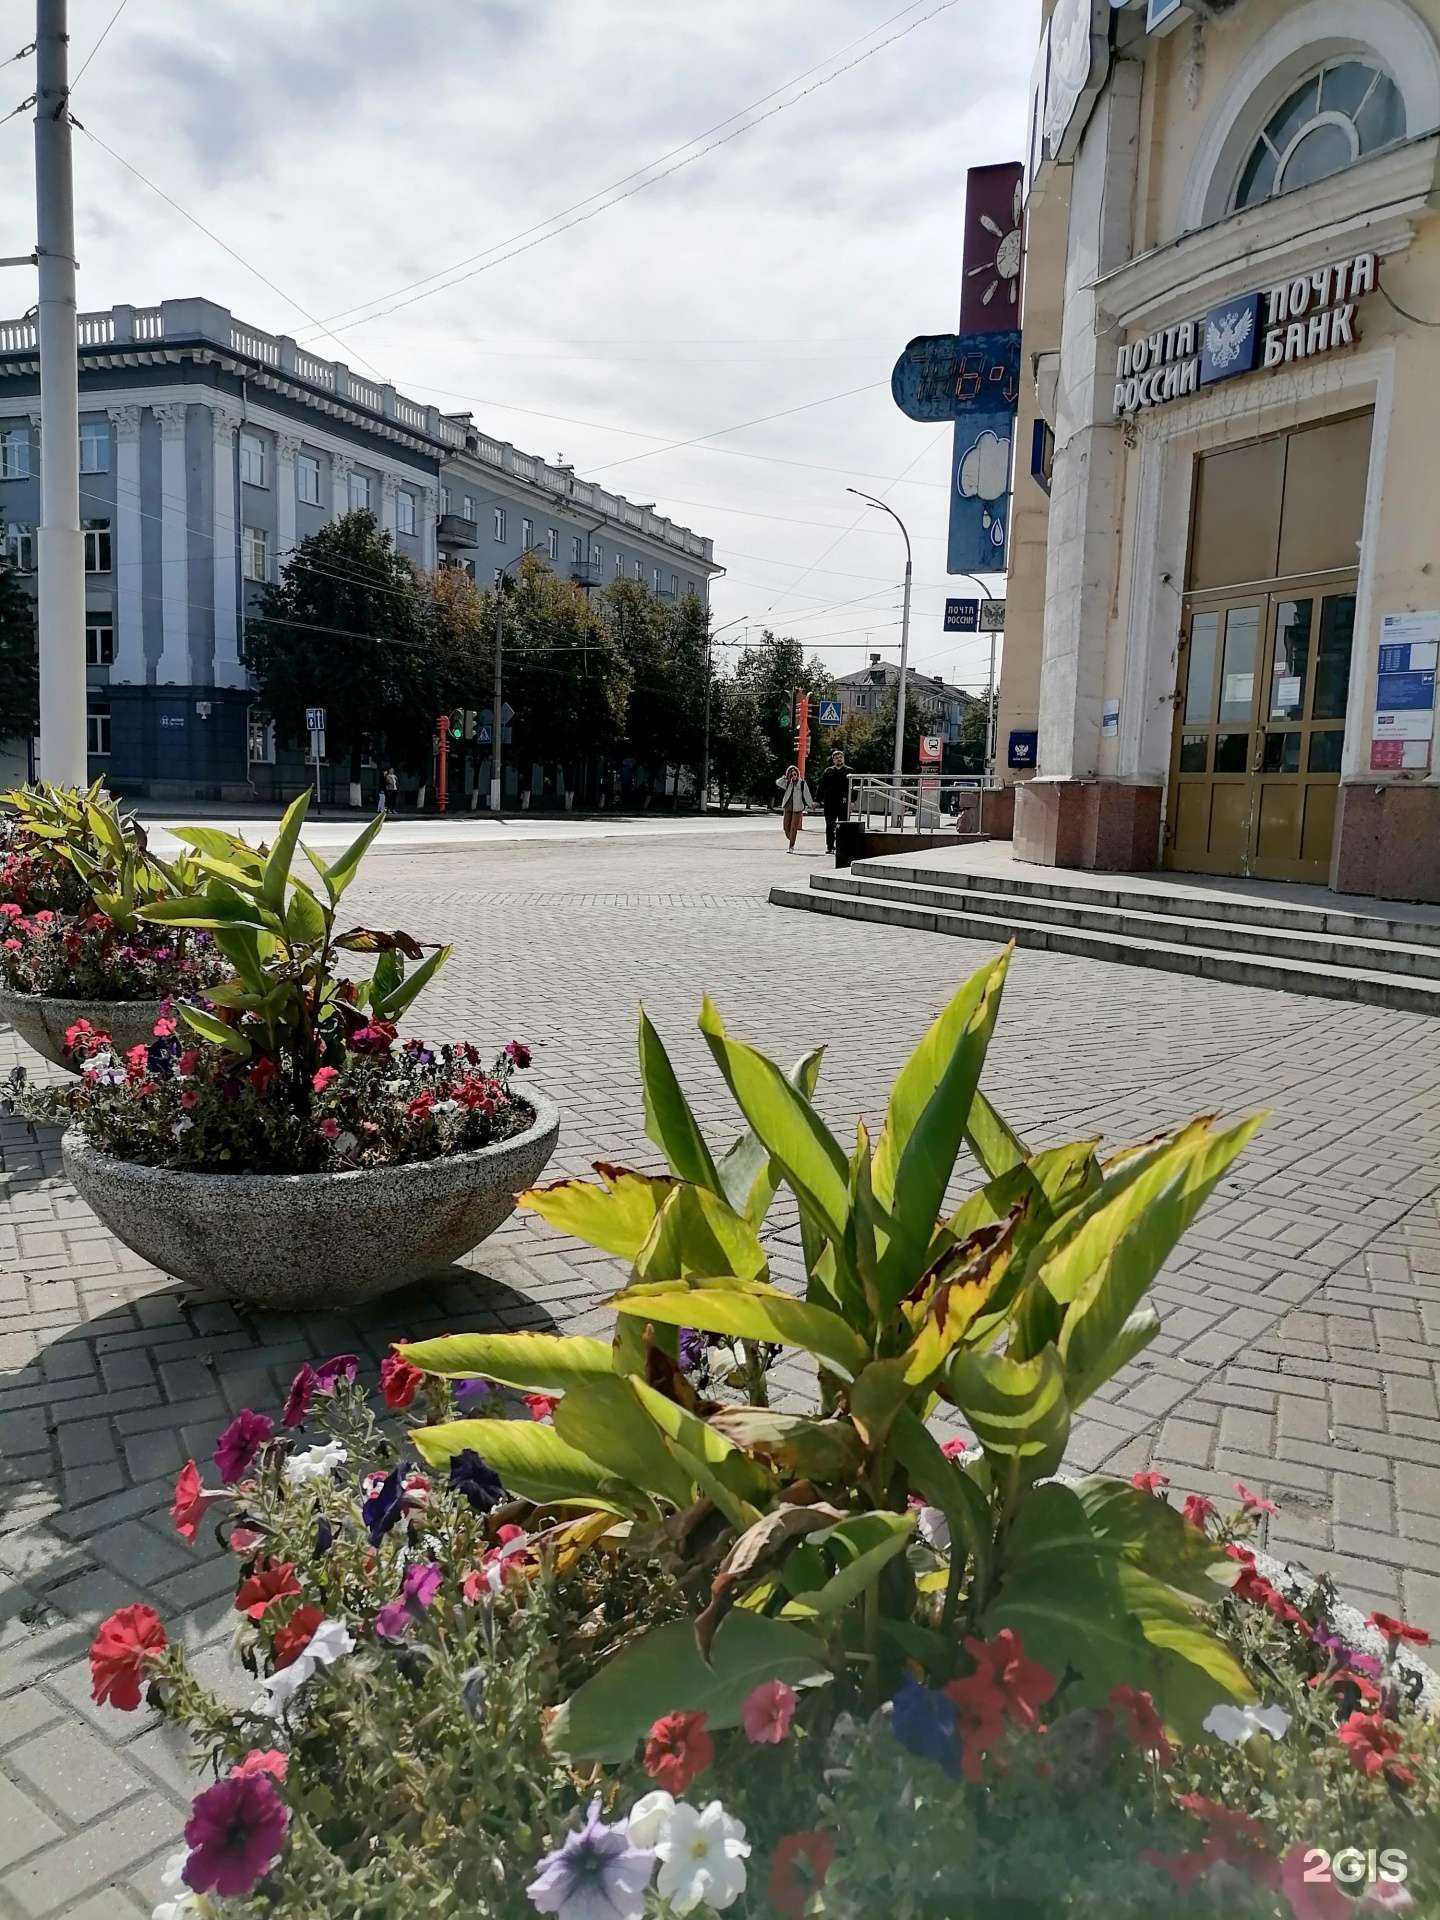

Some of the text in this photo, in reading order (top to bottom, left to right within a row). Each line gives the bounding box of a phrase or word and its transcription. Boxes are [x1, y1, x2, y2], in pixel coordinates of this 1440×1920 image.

[1267, 253, 1375, 324] ПОЧТА
[1116, 321, 1195, 378] ПОЧТА
[1263, 303, 1355, 368] БАНК
[1112, 357, 1198, 414] РОССИИ
[947, 616, 974, 624] РОССИИ
[948, 606, 974, 614] ПОЧТА
